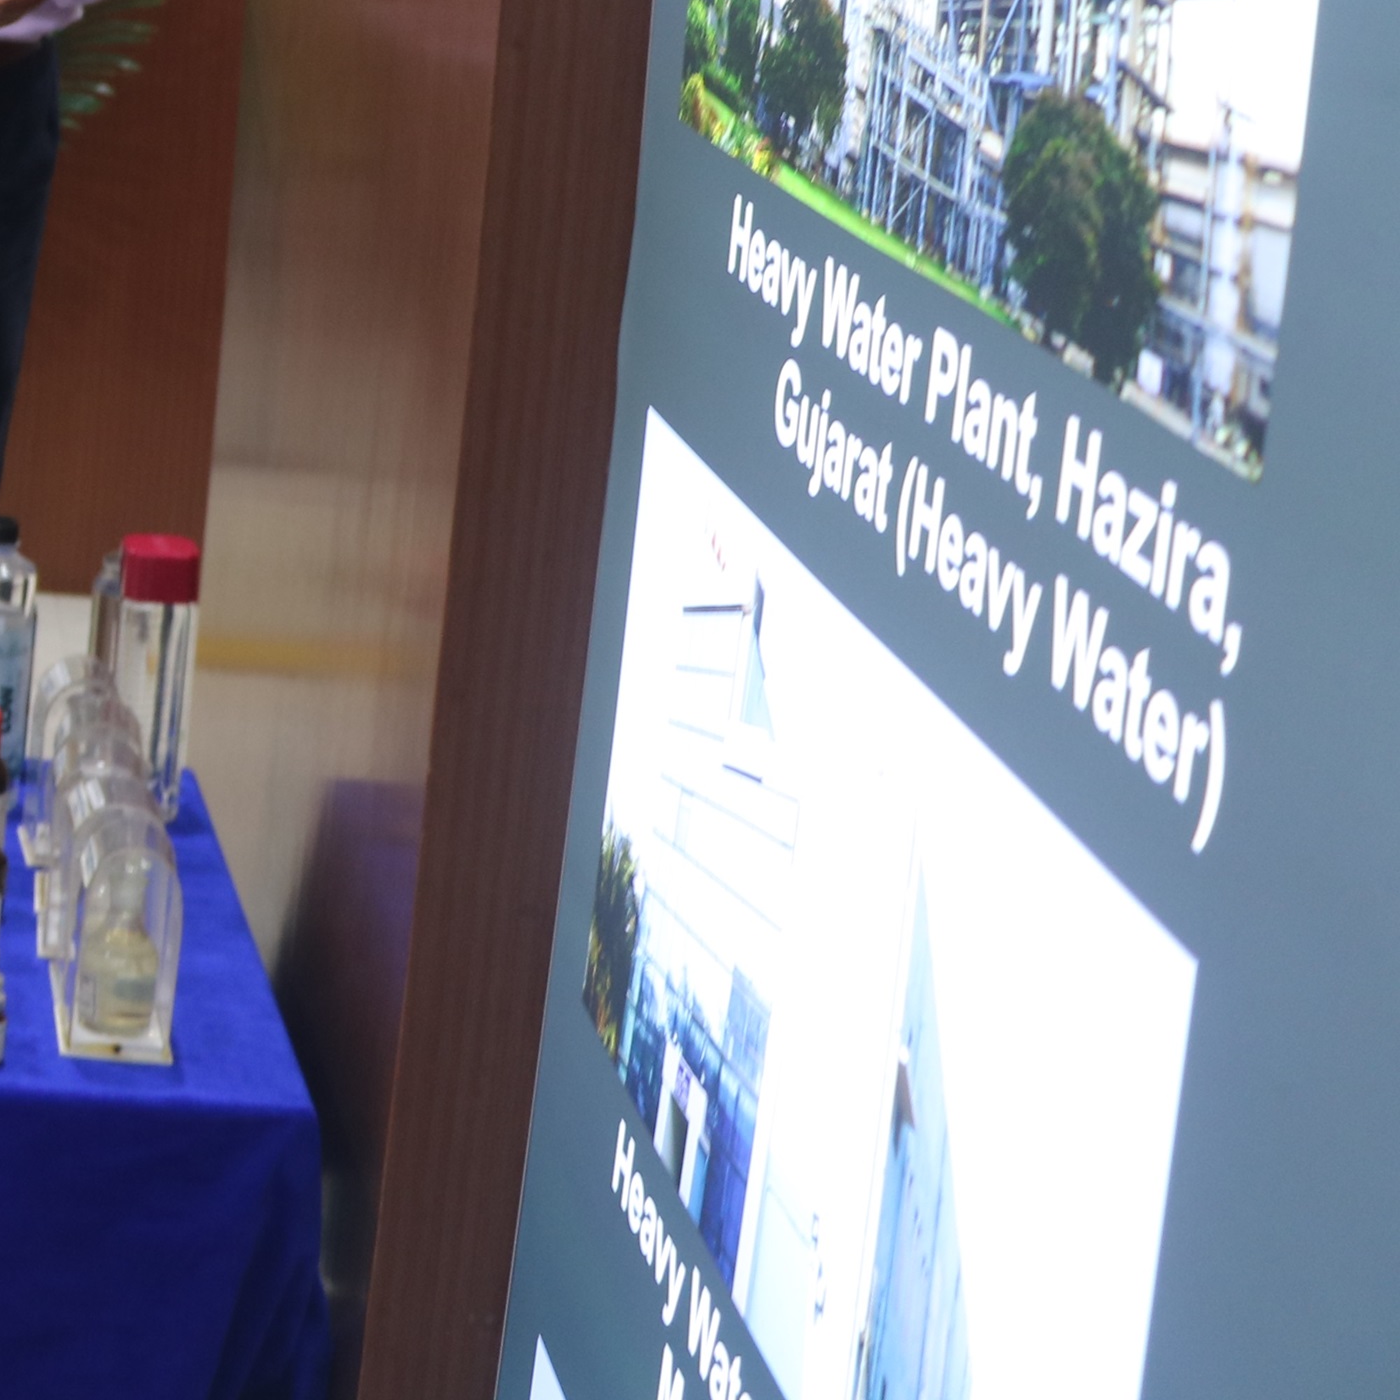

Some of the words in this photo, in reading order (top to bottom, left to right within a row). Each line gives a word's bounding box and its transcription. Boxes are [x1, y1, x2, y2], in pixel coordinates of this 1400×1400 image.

[727, 193, 818, 348] Heavy
[822, 256, 923, 406] Water
[924, 325, 1044, 521] Plant,
[1055, 414, 1243, 676] Hazira,
[773, 357, 893, 534] Gujarat
[896, 455, 1043, 677] (Heavy
[1050, 573, 1227, 854] Water)
[611, 1117, 686, 1327] Heavy
[687, 1264, 753, 1400] Wat
